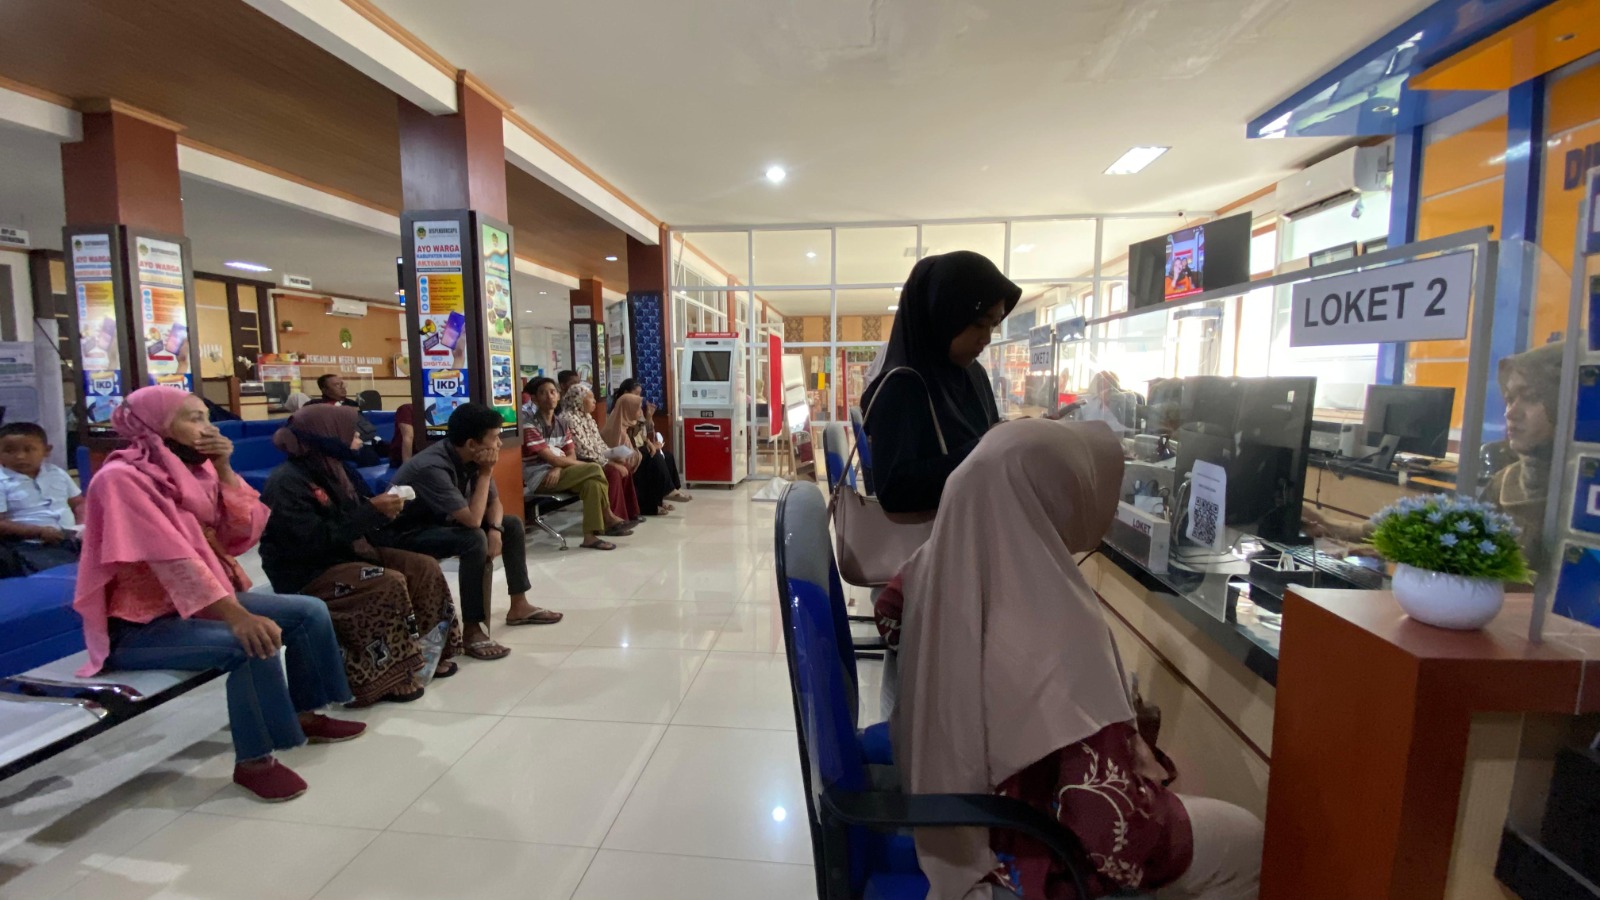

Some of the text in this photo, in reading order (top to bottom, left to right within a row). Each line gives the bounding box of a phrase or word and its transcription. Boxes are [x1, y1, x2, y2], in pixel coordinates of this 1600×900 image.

[433, 244, 460, 252] WARGA
[139, 261, 180, 272] AYO WARGA
[1304, 277, 1448, 328] LOKET 2
[96, 381, 112, 389] IKD
[436, 380, 456, 389] IKD
[1132, 518, 1152, 535] LOKET
